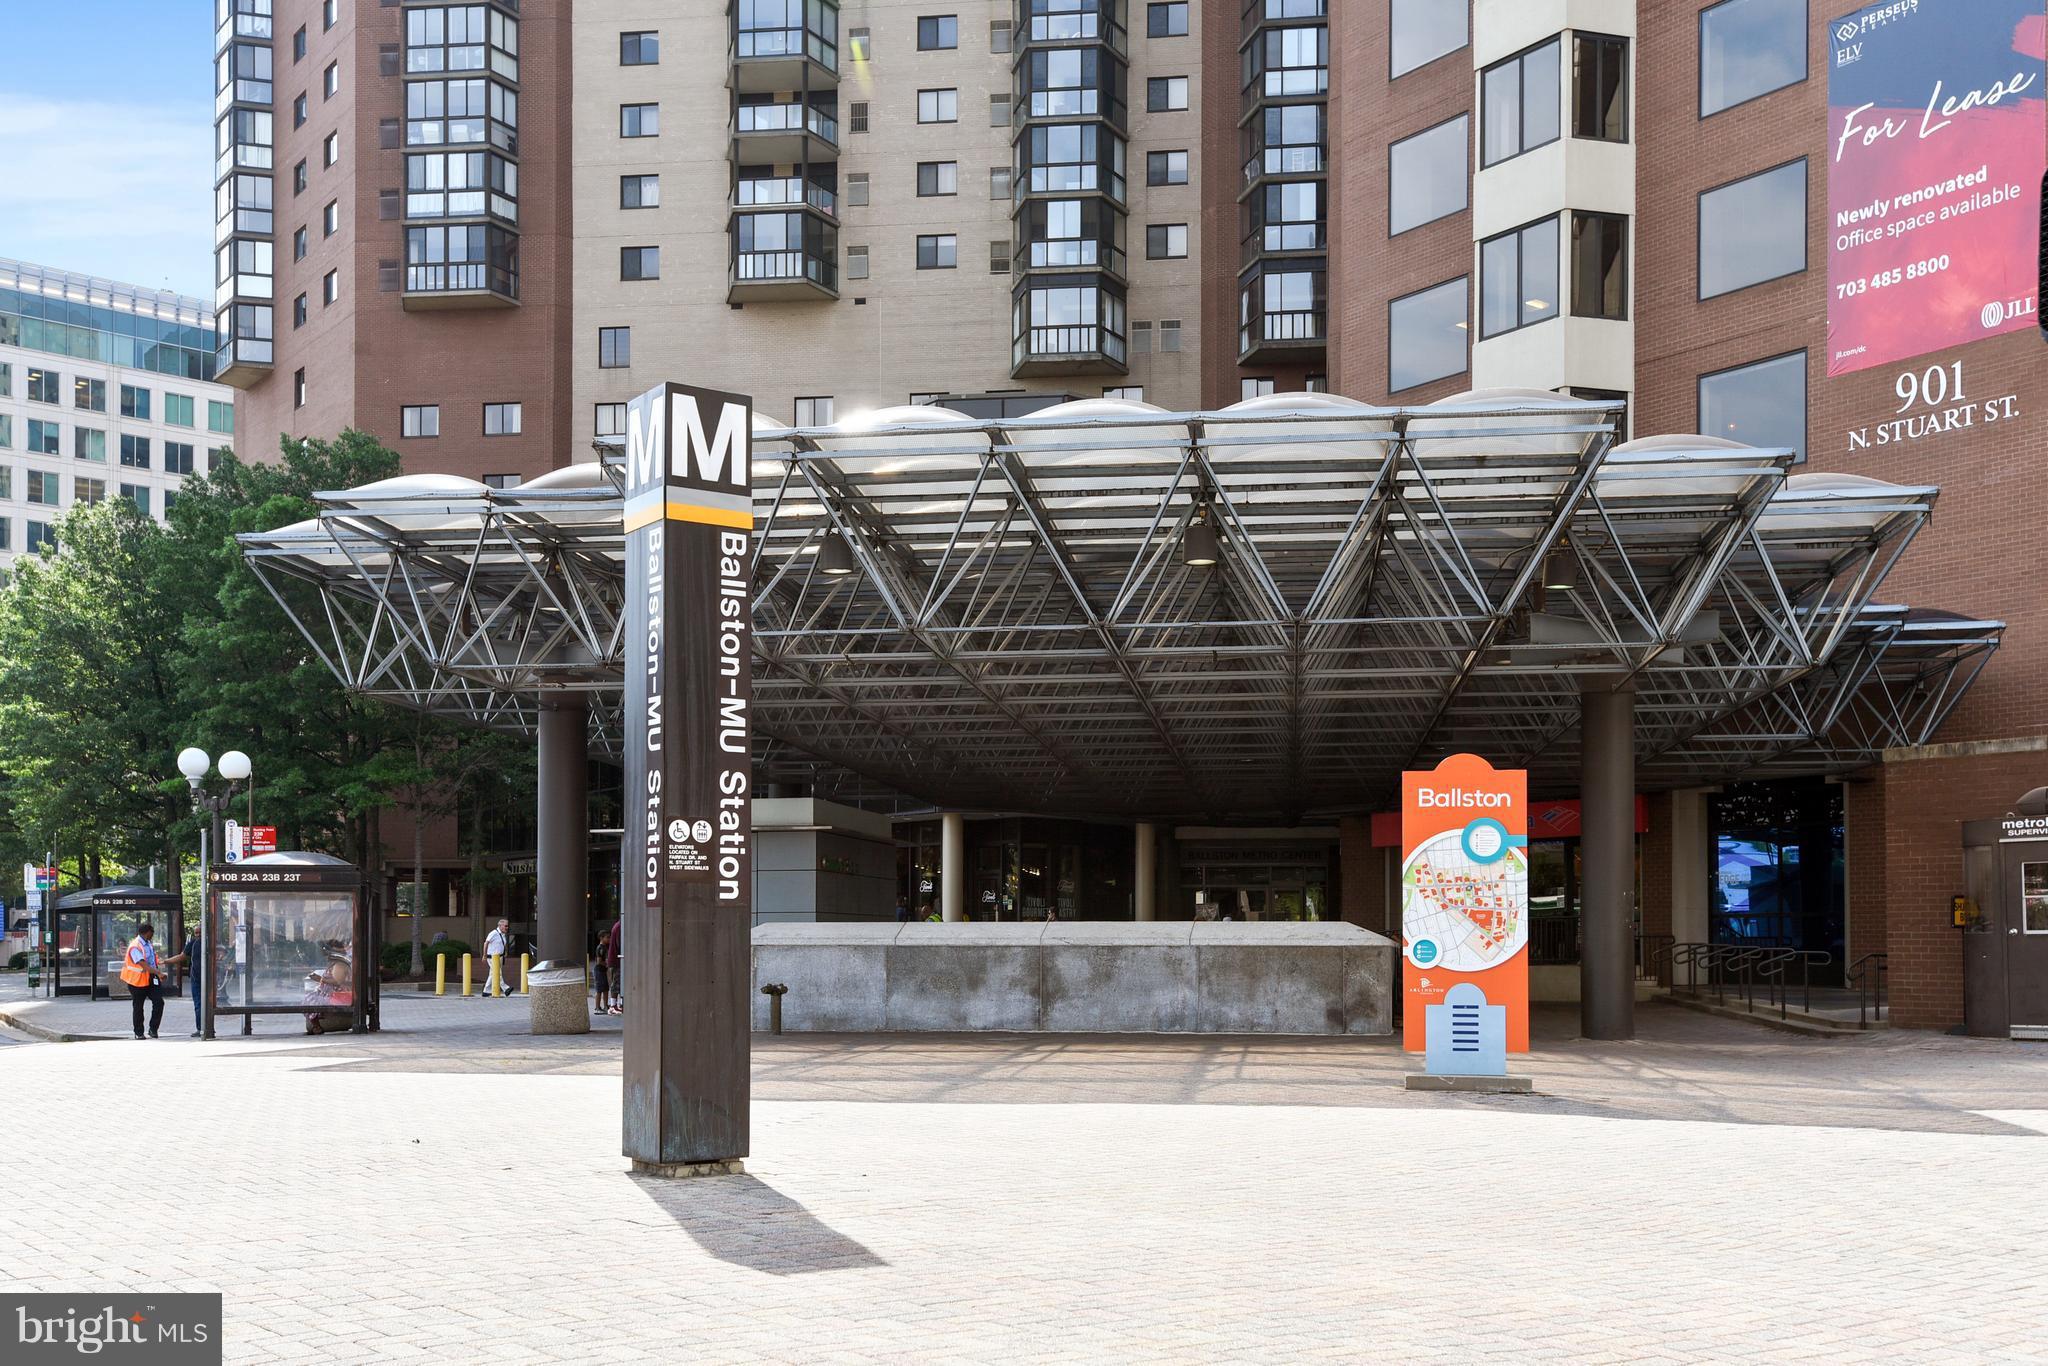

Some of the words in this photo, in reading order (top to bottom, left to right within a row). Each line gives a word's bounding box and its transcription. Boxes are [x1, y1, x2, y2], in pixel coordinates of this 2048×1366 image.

[1861, 0, 1918, 28] PERSEUS
[1837, 42, 1863, 63] ELV
[1836, 102, 1906, 162] For
[1919, 71, 2036, 139] Lease
[1836, 197, 1890, 228] Newly
[1894, 165, 1988, 206] renovated
[1836, 219, 1883, 252] Office
[1887, 210, 1936, 241] space
[1940, 183, 2022, 221] available
[1836, 279, 1867, 300] 703
[1871, 268, 1902, 290] 485
[1906, 254, 1950, 281] 8800
[2004, 297, 2036, 320] JLL
[1836, 344, 1867, 361] jll.com/dc
[1895, 360, 1966, 414] 901
[628, 395, 663, 491] M
[671, 392, 747, 487] M
[1848, 428, 1870, 452] N.
[1876, 404, 1977, 446] STUART
[1984, 395, 2020, 423] ST.
[647, 527, 662, 752] Ballston-MU
[719, 532, 747, 754] Ballston-MU
[1418, 788, 1512, 808] Ballston
[646, 769, 661, 901] Station
[719, 769, 747, 900] Station
[1242, 851, 1278, 861] METRO
[221, 873, 238, 882] 10B
[241, 873, 259, 882] 23A
[262, 873, 281, 882] 23B
[283, 873, 301, 882] 23T
